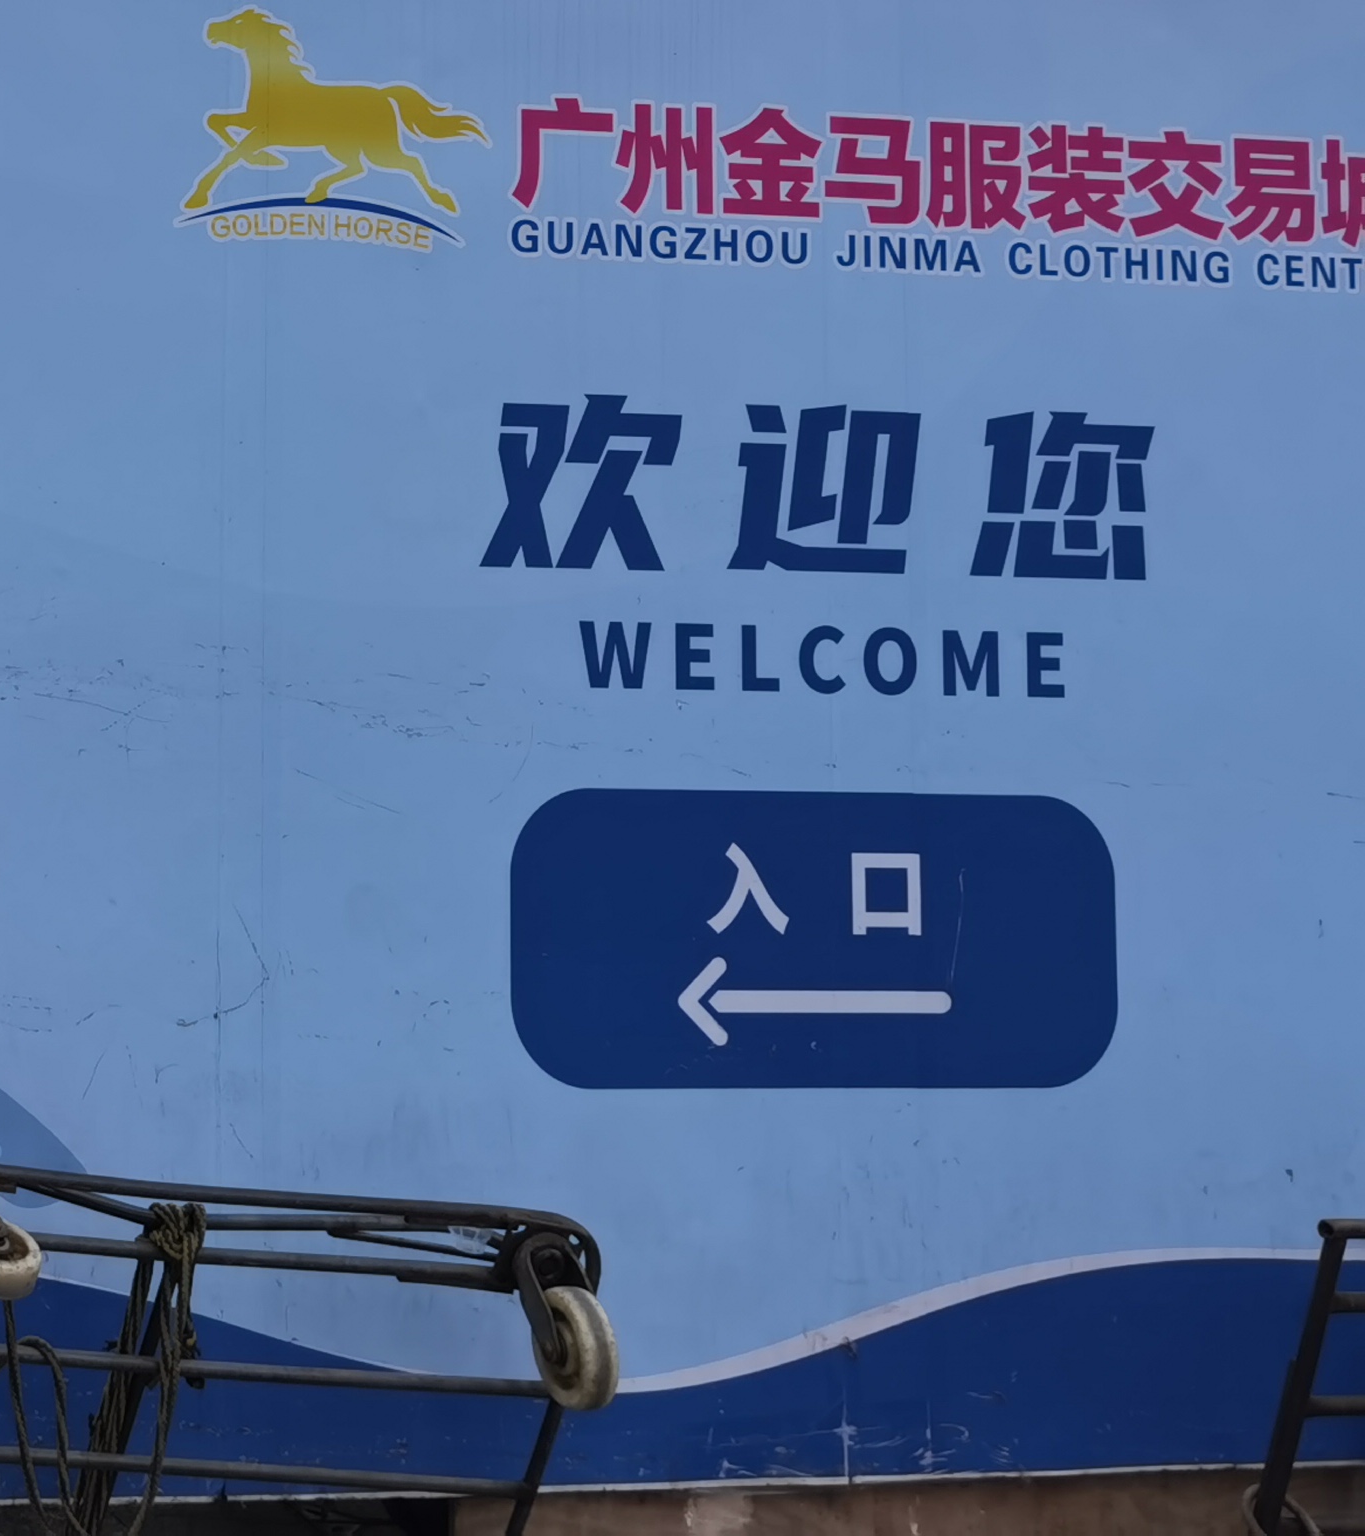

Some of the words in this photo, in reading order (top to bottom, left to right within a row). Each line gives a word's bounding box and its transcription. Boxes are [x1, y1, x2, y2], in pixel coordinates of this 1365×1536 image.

[211, 211, 327, 240] GOLDEN
[333, 214, 432, 250] HORSE
[511, 218, 809, 265] GUANGZHOU
[836, 234, 982, 274] JINMA
[1007, 242, 1231, 284] CLOTHING
[479, 394, 1156, 581] 欢迎您
[579, 620, 1066, 699] WELCOME
[706, 842, 922, 937] 入口
